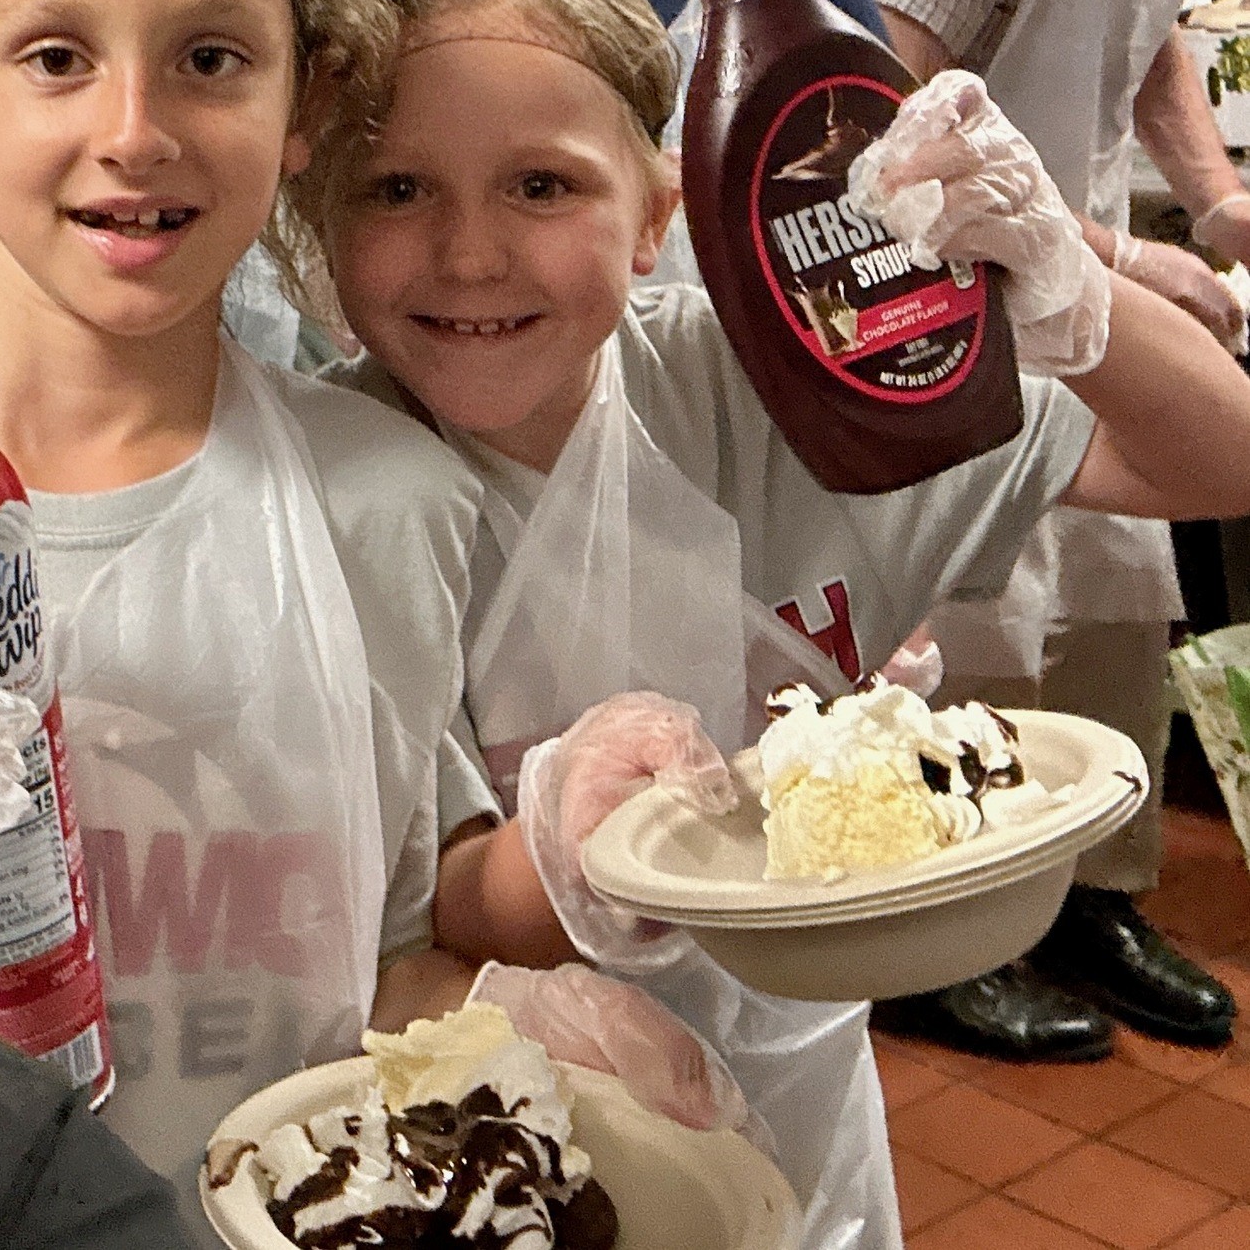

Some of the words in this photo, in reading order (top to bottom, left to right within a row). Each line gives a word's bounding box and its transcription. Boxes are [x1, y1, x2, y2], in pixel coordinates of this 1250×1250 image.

[850, 241, 912, 289] SYRUP
[862, 313, 917, 342] CHOCOLATE
[916, 300, 949, 321] FLAVOR
[880, 299, 923, 323] GENUINE
[22, 737, 47, 758] cts
[33, 788, 54, 814] 15
